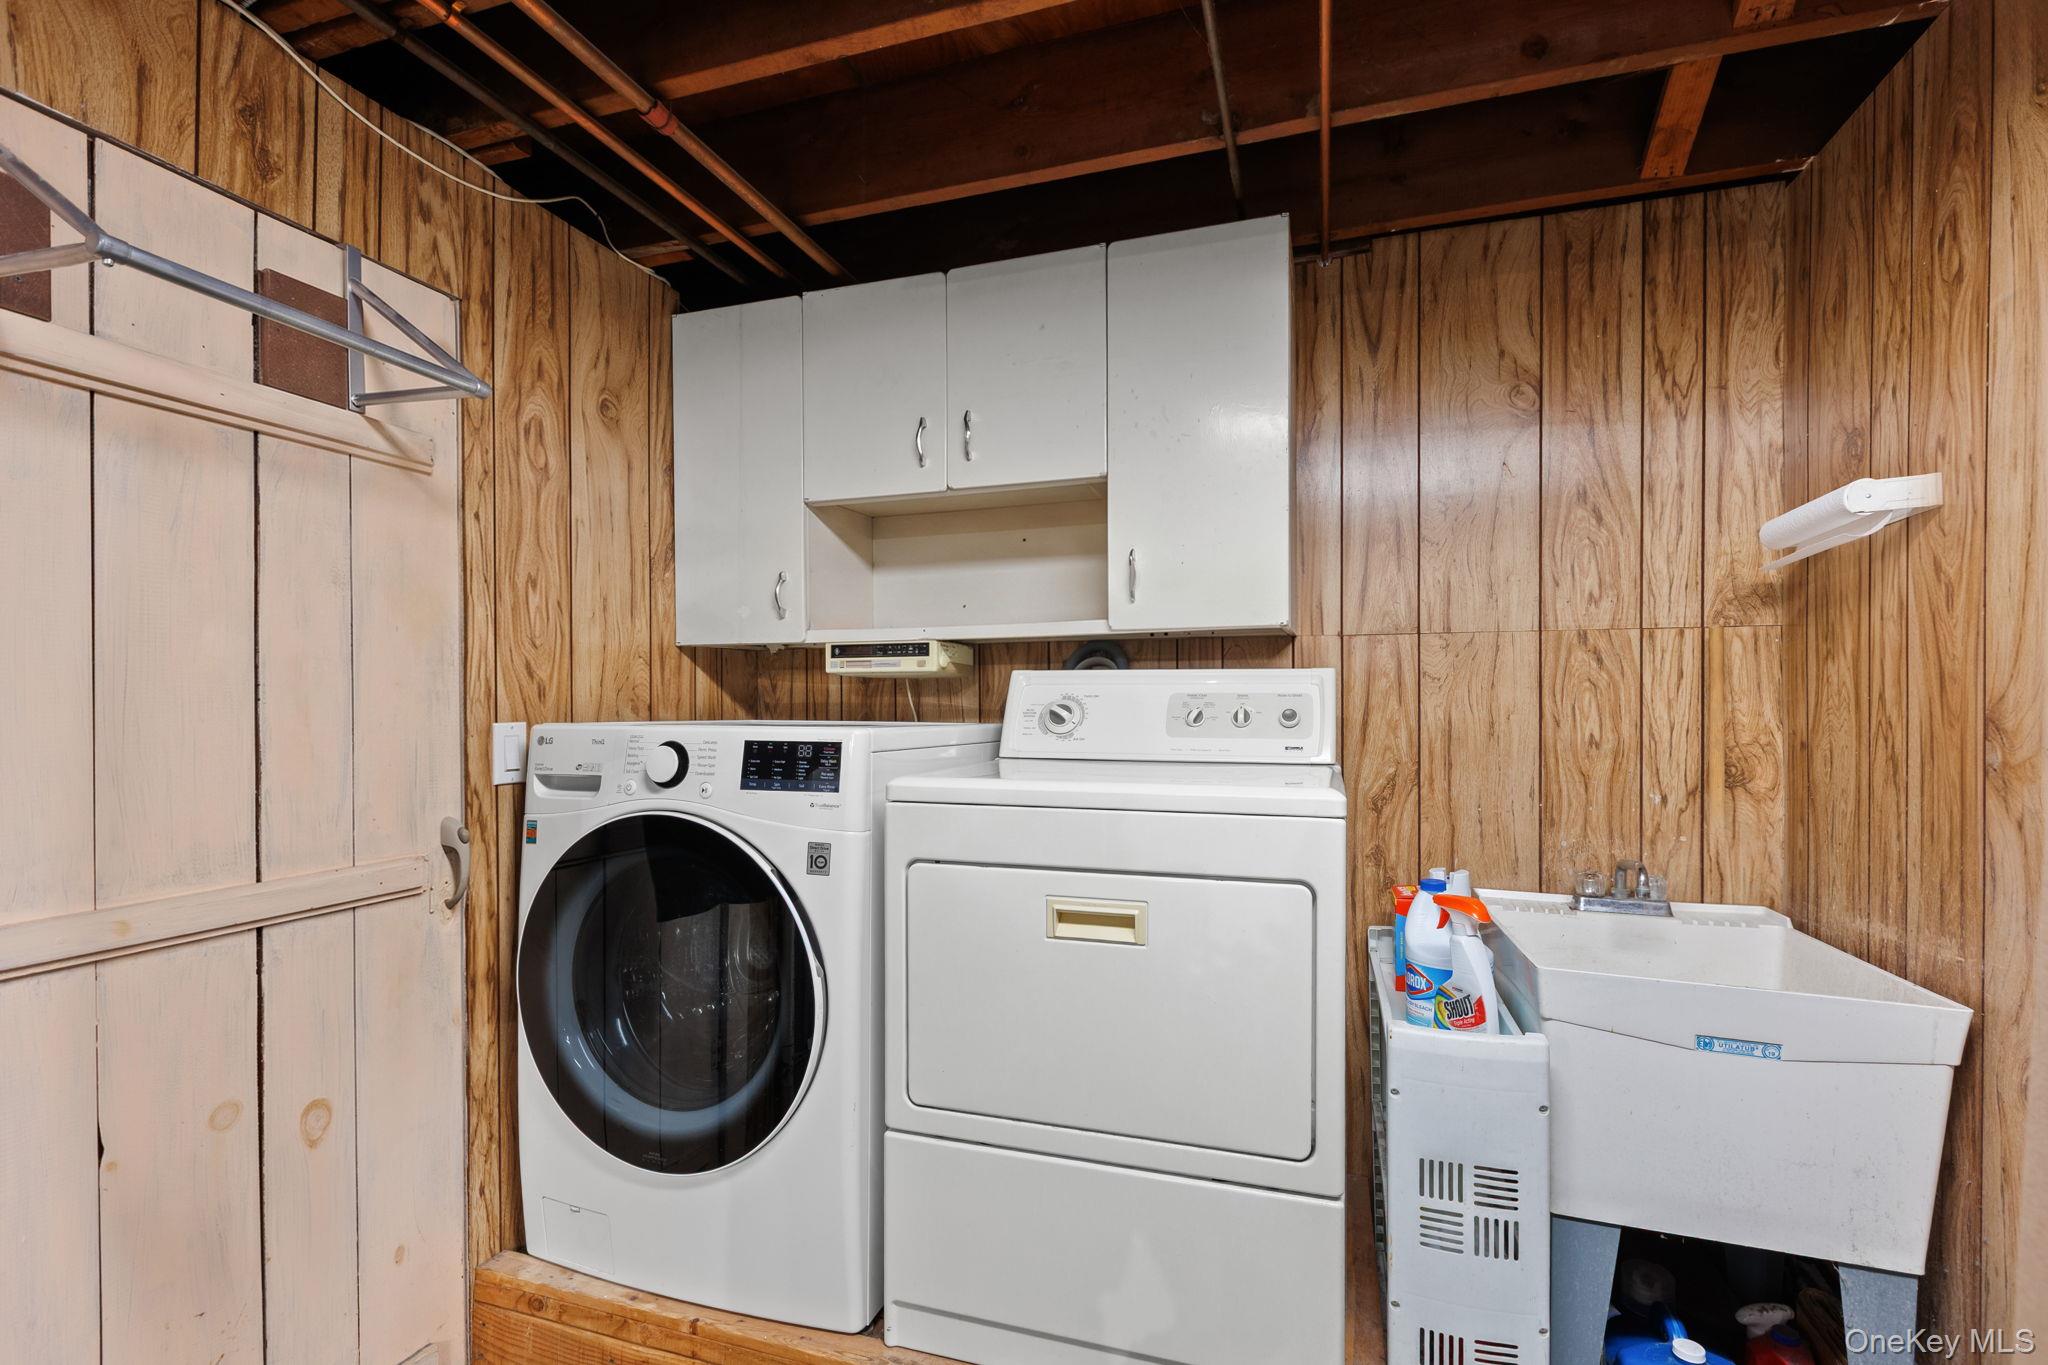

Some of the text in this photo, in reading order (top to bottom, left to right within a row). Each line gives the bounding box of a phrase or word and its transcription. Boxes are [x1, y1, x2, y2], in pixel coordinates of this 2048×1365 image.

[797, 744, 813, 757] 88
[810, 854, 828, 870] 10
[1407, 971, 1427, 990] OROX
[1443, 994, 1475, 1020] SHOUT
